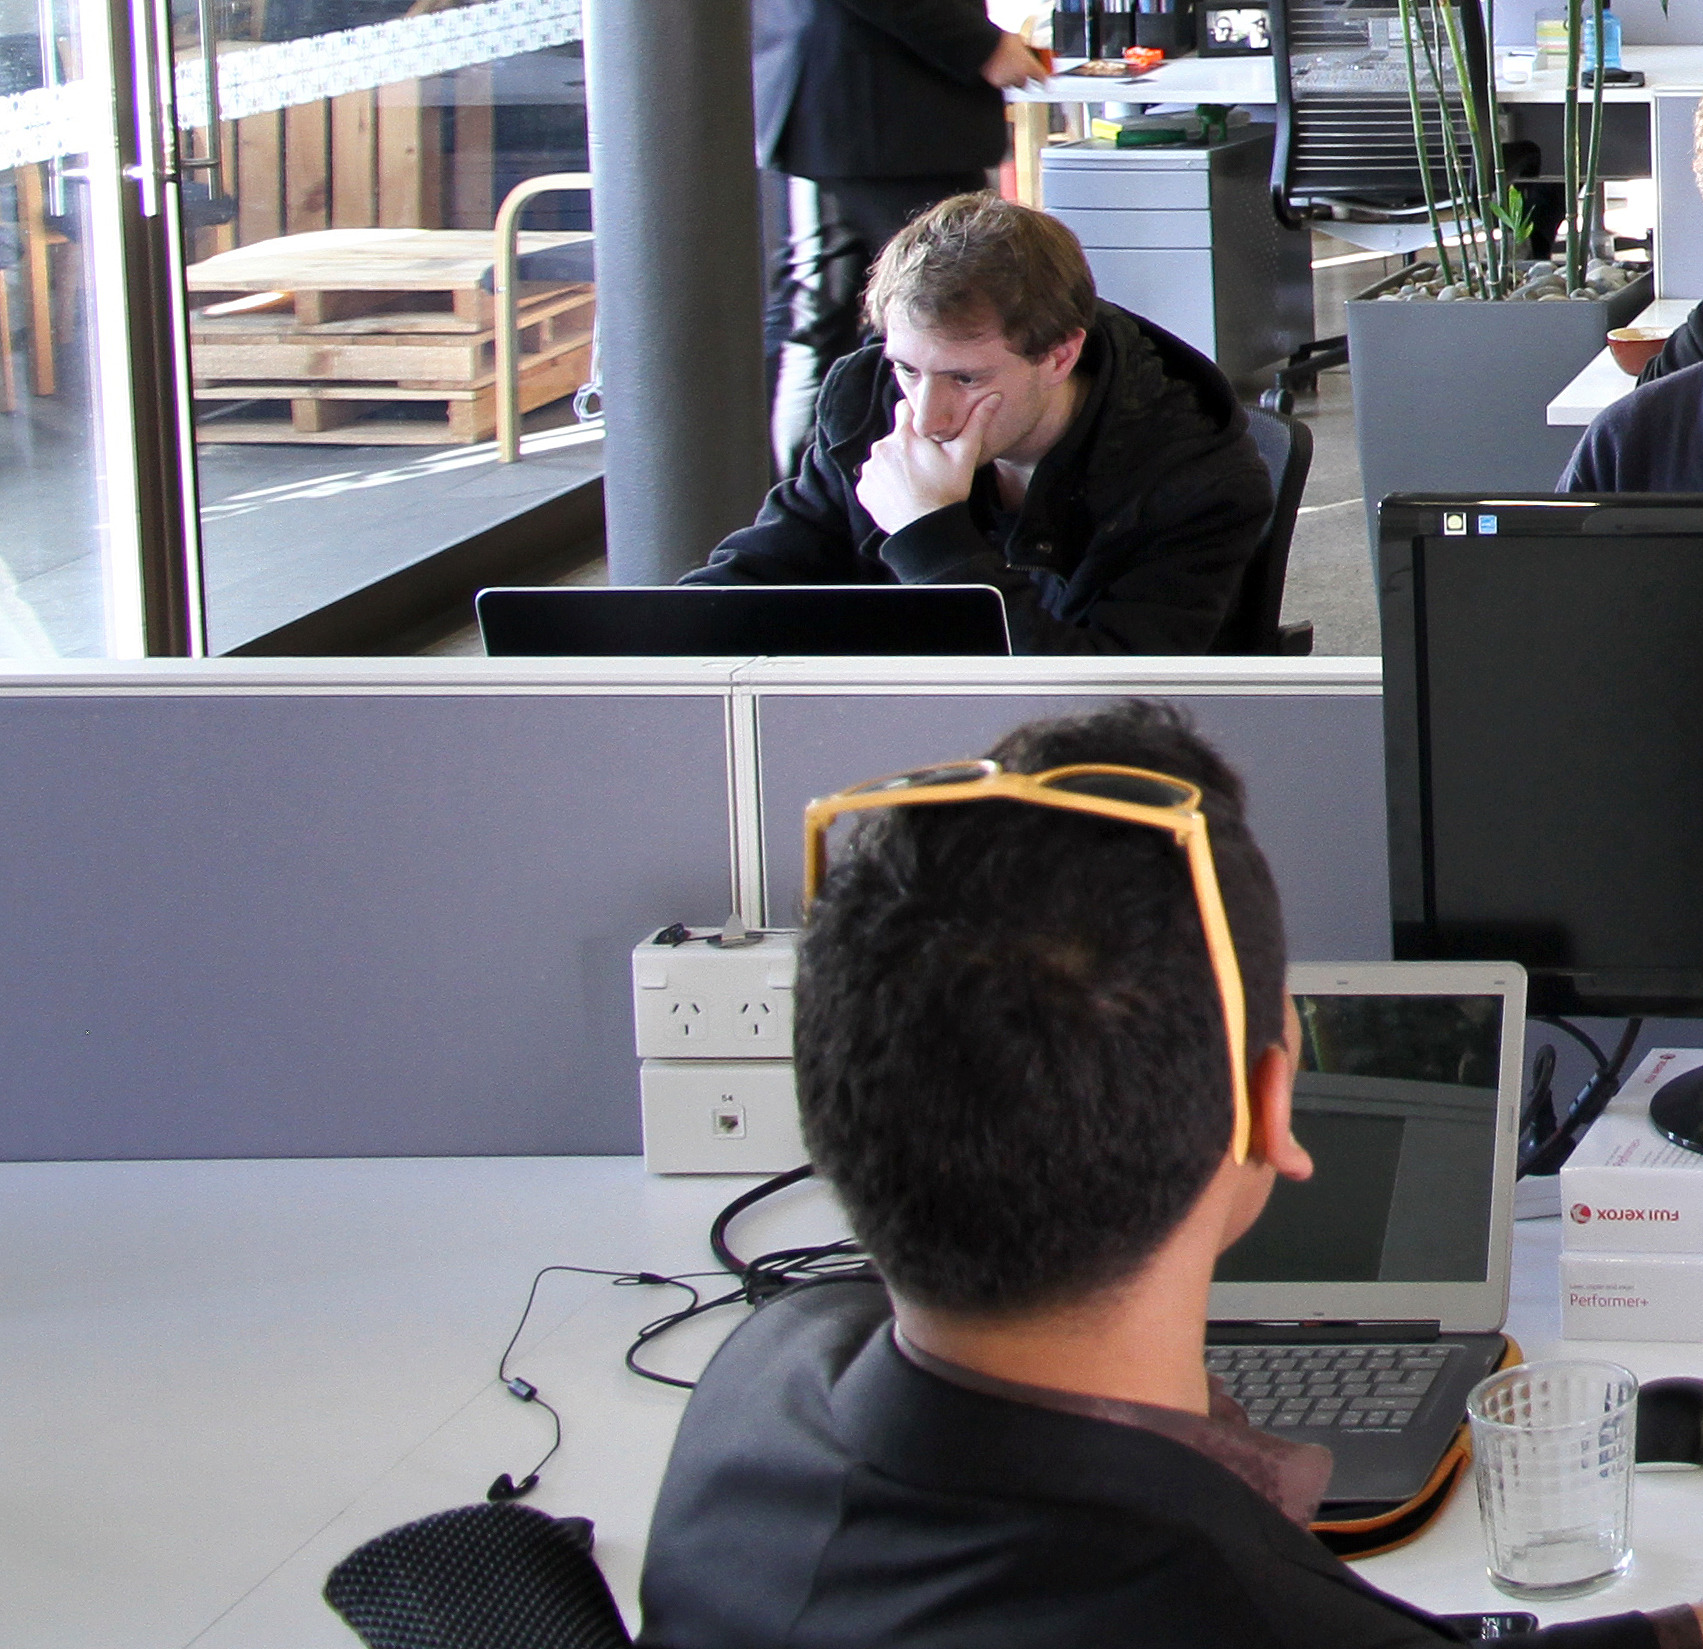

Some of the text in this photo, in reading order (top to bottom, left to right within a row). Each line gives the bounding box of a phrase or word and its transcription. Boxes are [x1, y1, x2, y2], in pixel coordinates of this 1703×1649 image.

[1596, 1208, 1680, 1222] FUJI xerox
[1569, 1292, 1649, 1308] Performer+
